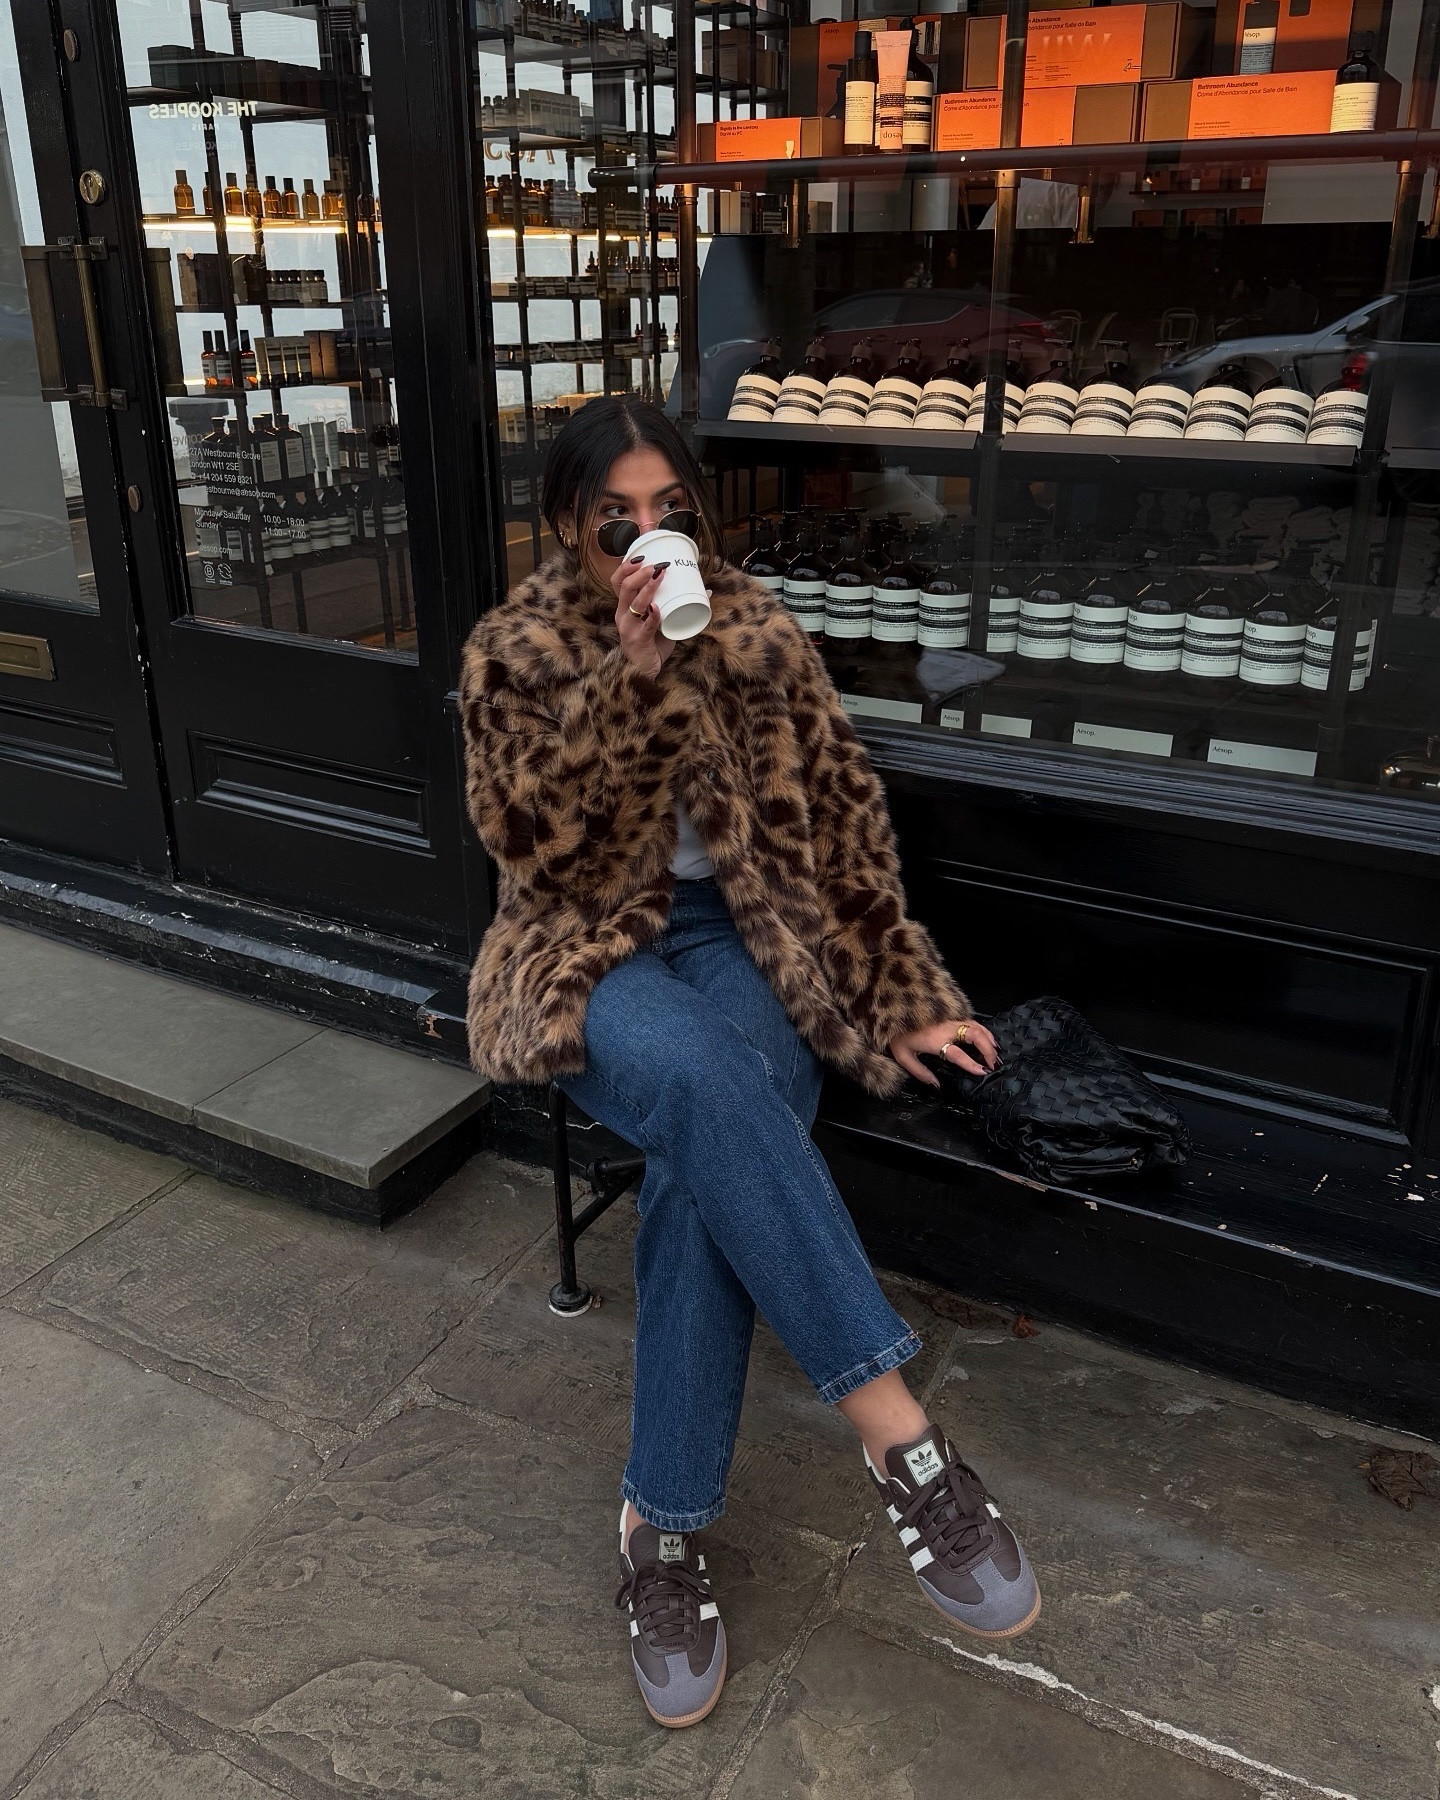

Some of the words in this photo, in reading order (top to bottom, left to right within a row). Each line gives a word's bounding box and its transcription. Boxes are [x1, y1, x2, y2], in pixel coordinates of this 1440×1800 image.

[1226, 81, 1259, 89] Abundance
[969, 96, 997, 104] Abundance
[203, 448, 240, 459] Westbourne
[241, 450, 261, 461] Grove
[211, 461, 224, 470] W11
[226, 462, 240, 471] 2SE
[211, 473, 223, 482] 204
[224, 474, 236, 483] 559
[204, 485, 276, 500] estbourne@aesop.com
[196, 519, 219, 531] Sunday
[917, 1462, 939, 1477] adidas
[662, 1552, 680, 1560] adidas
